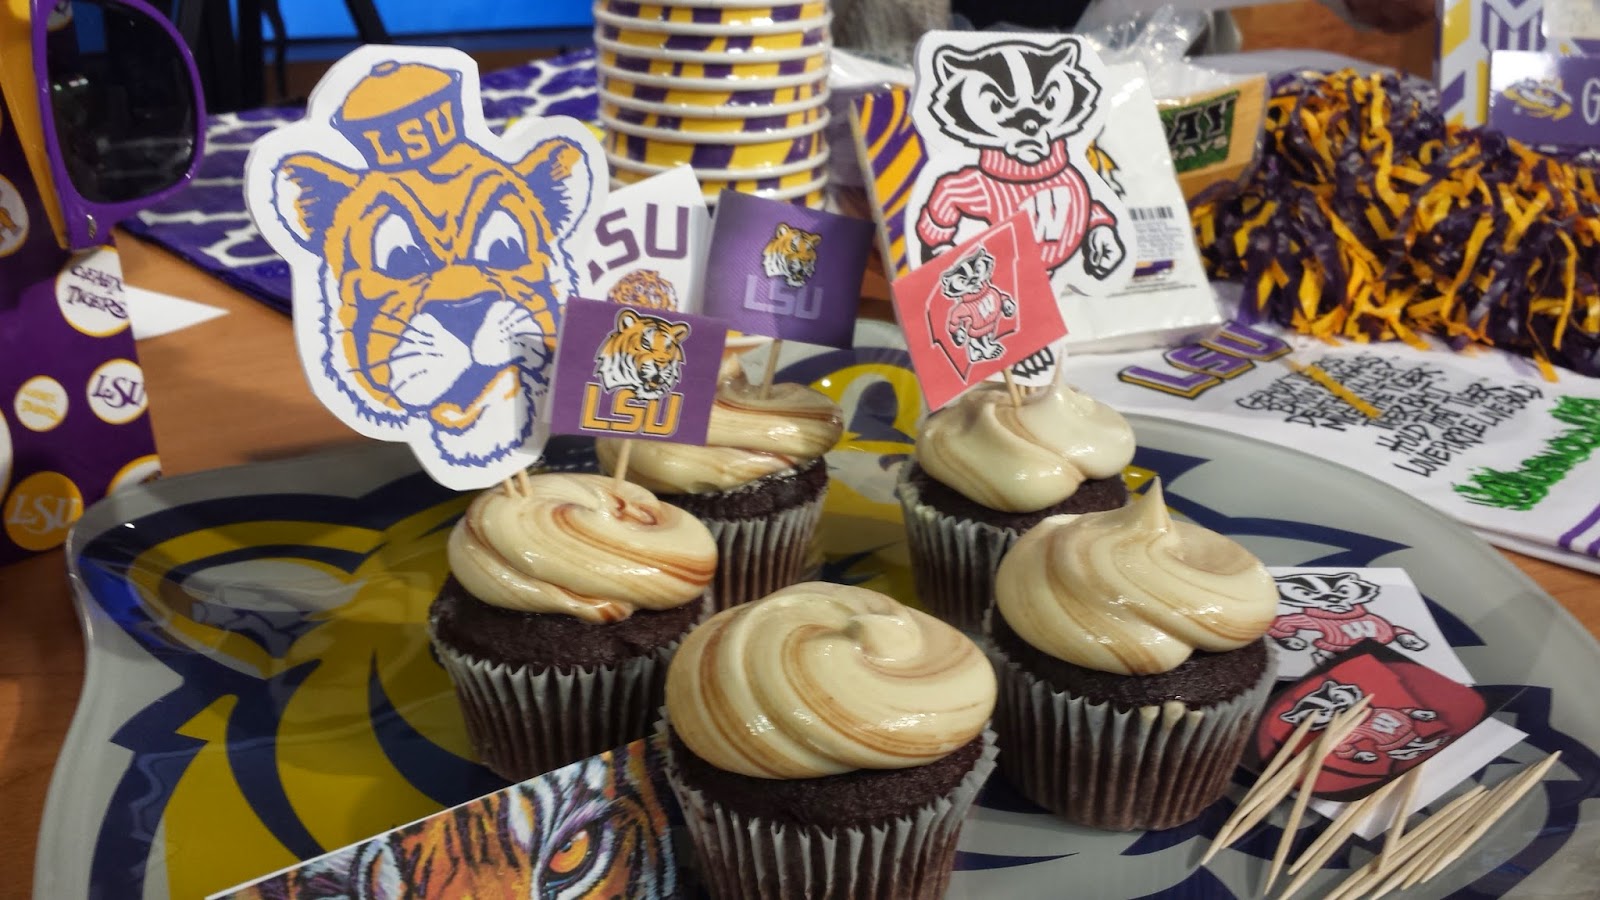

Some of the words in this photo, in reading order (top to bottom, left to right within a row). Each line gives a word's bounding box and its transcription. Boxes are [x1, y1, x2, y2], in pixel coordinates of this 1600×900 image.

[363, 101, 457, 166] LSU
[587, 202, 690, 286] SU
[65, 284, 129, 319] TIGERS
[743, 274, 824, 320] LSU
[1117, 319, 1293, 400] LSU
[92, 375, 144, 409] LSU
[579, 382, 684, 437] LSU
[1393, 446, 1451, 477] LOVE
[8, 495, 81, 535] LSU
